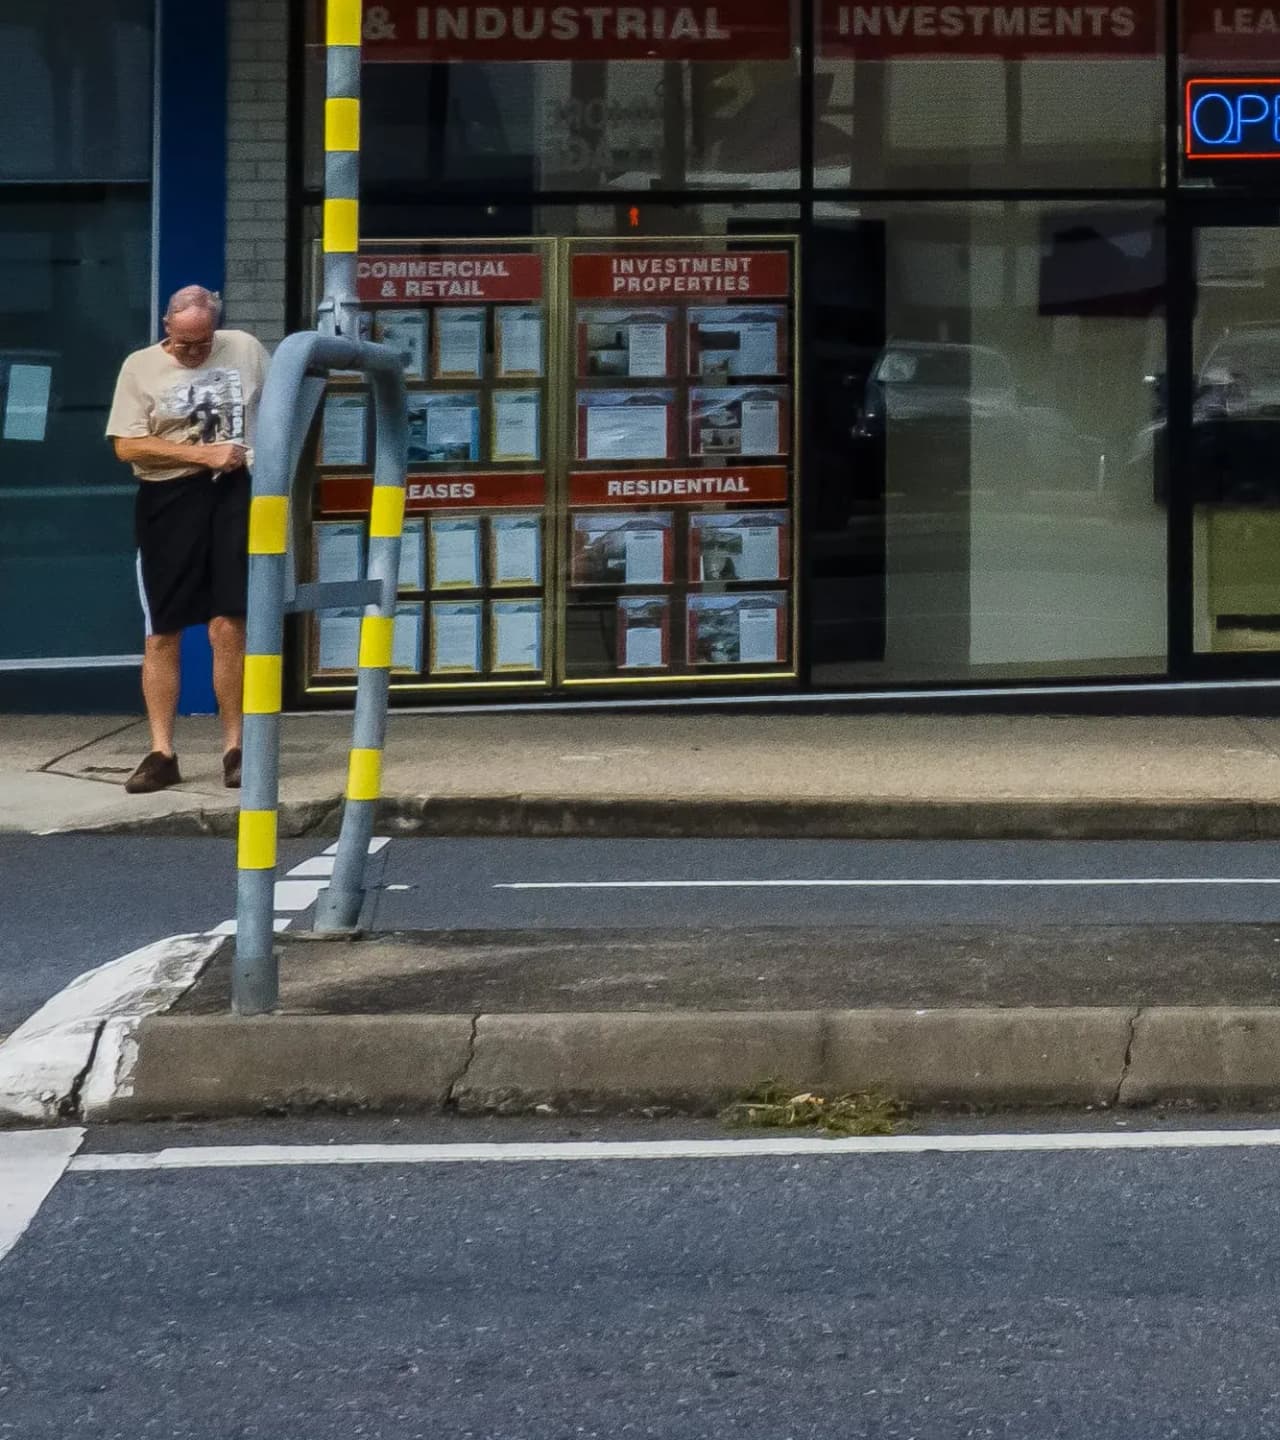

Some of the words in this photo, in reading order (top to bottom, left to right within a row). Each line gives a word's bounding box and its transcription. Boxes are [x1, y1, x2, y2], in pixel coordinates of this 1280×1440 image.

[361, 6, 396, 40] &
[417, 7, 730, 41] INDUSTRIAL
[838, 6, 1136, 37] INVESTMENTS
[357, 260, 509, 278] COMMERCIAL
[612, 257, 752, 274] INVESTMENT
[405, 279, 484, 297] RETAIL
[613, 275, 750, 292] PROPERTIES
[406, 483, 475, 499] EASES
[607, 477, 749, 497] RESIDENTIAL
